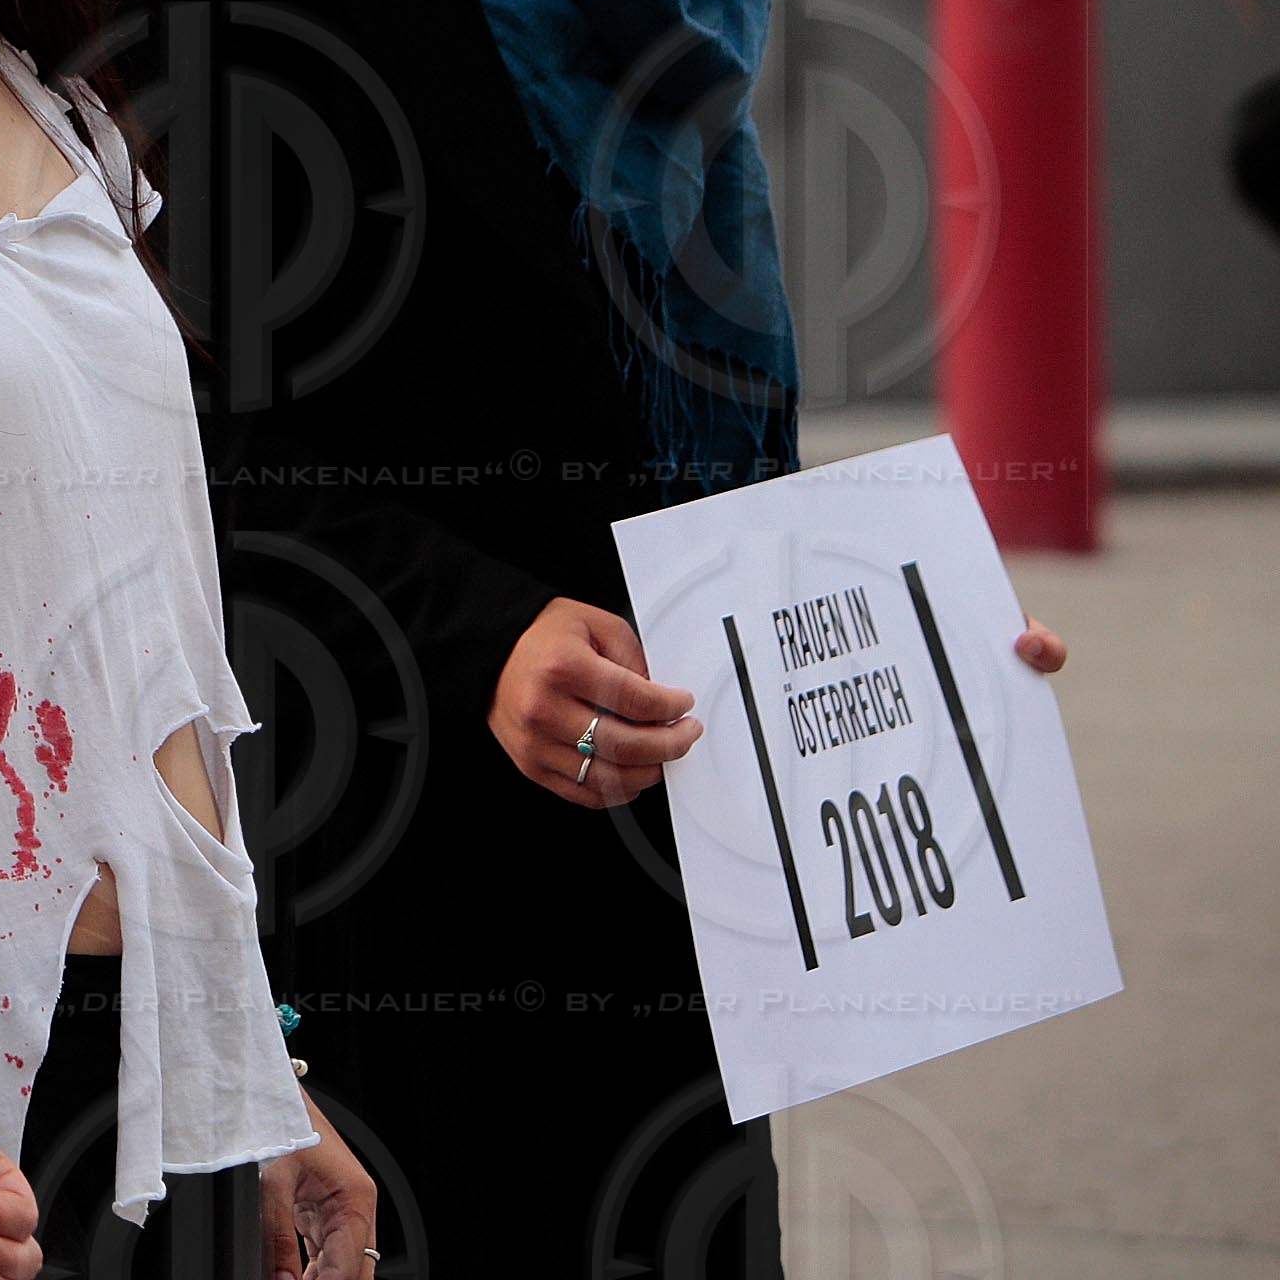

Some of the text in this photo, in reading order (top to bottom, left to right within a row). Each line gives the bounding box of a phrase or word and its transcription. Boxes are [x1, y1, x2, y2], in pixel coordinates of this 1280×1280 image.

[772, 584, 880, 672] FRAUEN IN
[783, 664, 913, 758] ÖSTERREICH
[820, 774, 955, 939] 2018
